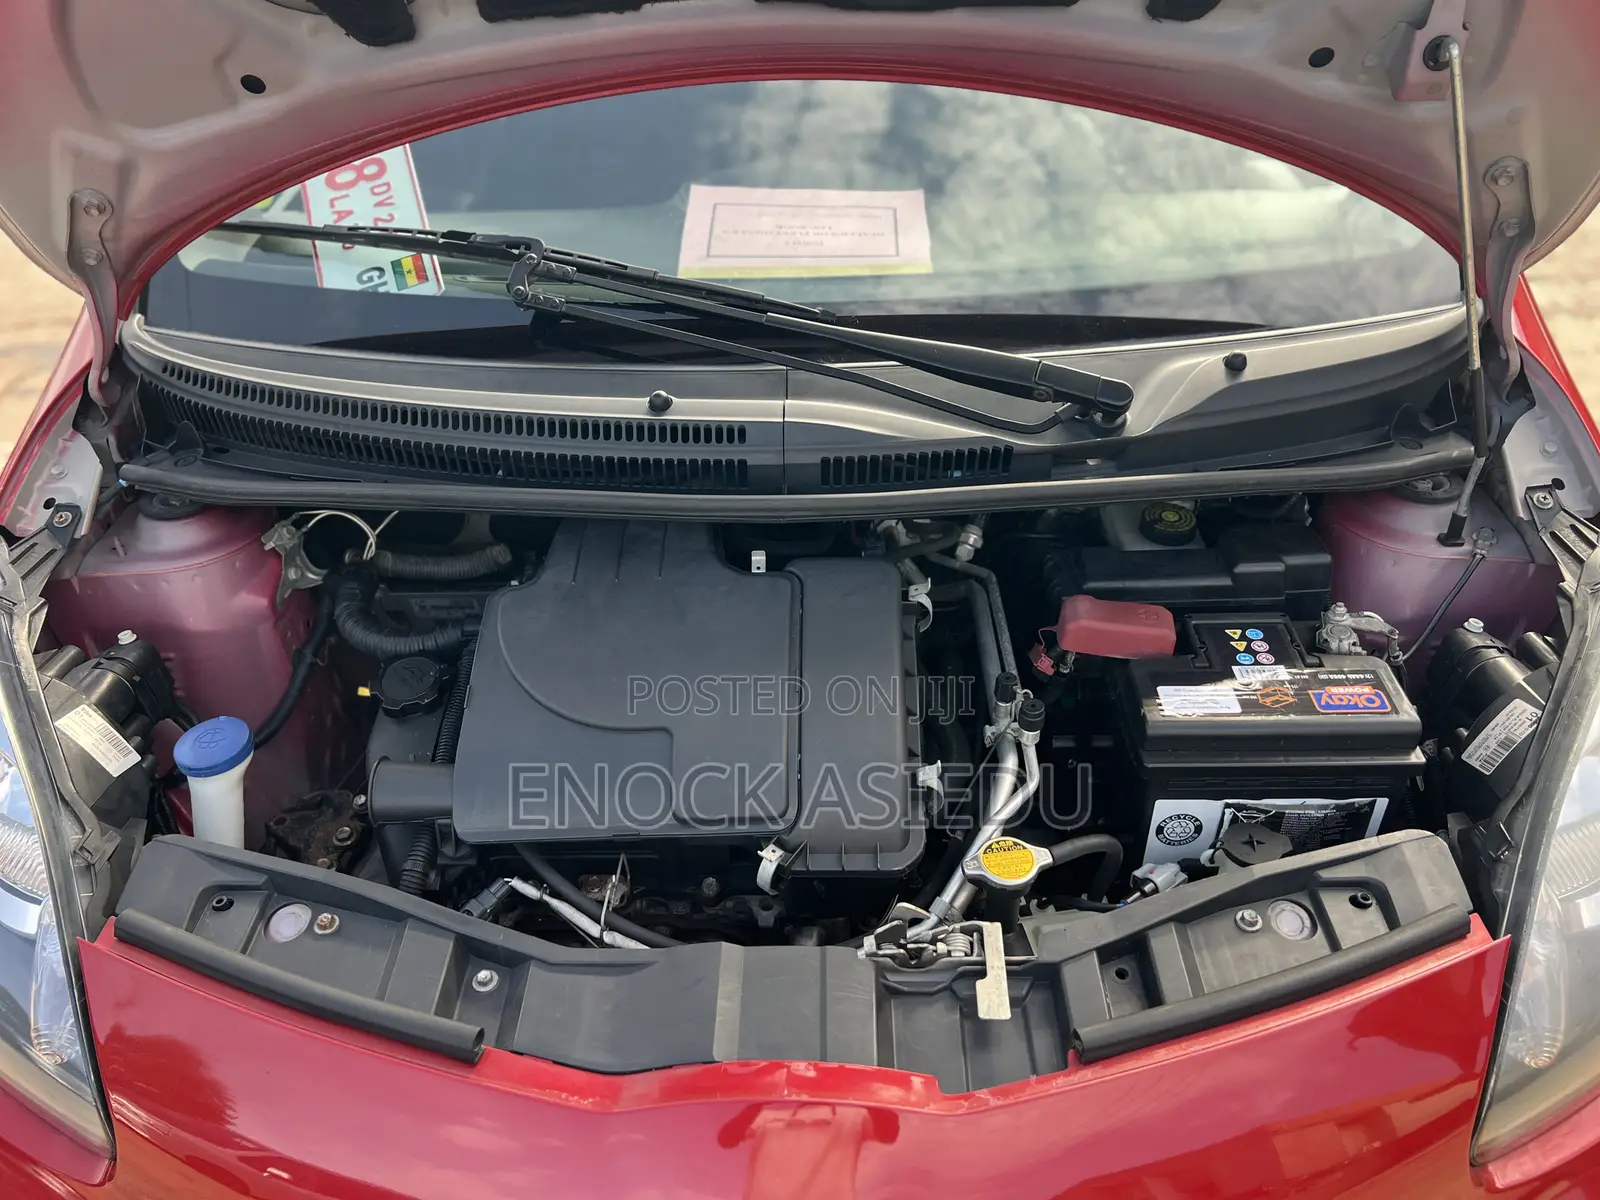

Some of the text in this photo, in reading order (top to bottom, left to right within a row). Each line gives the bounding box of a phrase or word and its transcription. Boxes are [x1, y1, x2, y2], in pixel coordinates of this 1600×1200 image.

[369, 181, 396, 208] DV
[1329, 686, 1371, 694] POWER
[1320, 692, 1381, 708] Okay
[1159, 814, 1201, 827] RECYCLE
[1157, 832, 1199, 846] BATTERIES
[986, 844, 1024, 854] CAUTION
